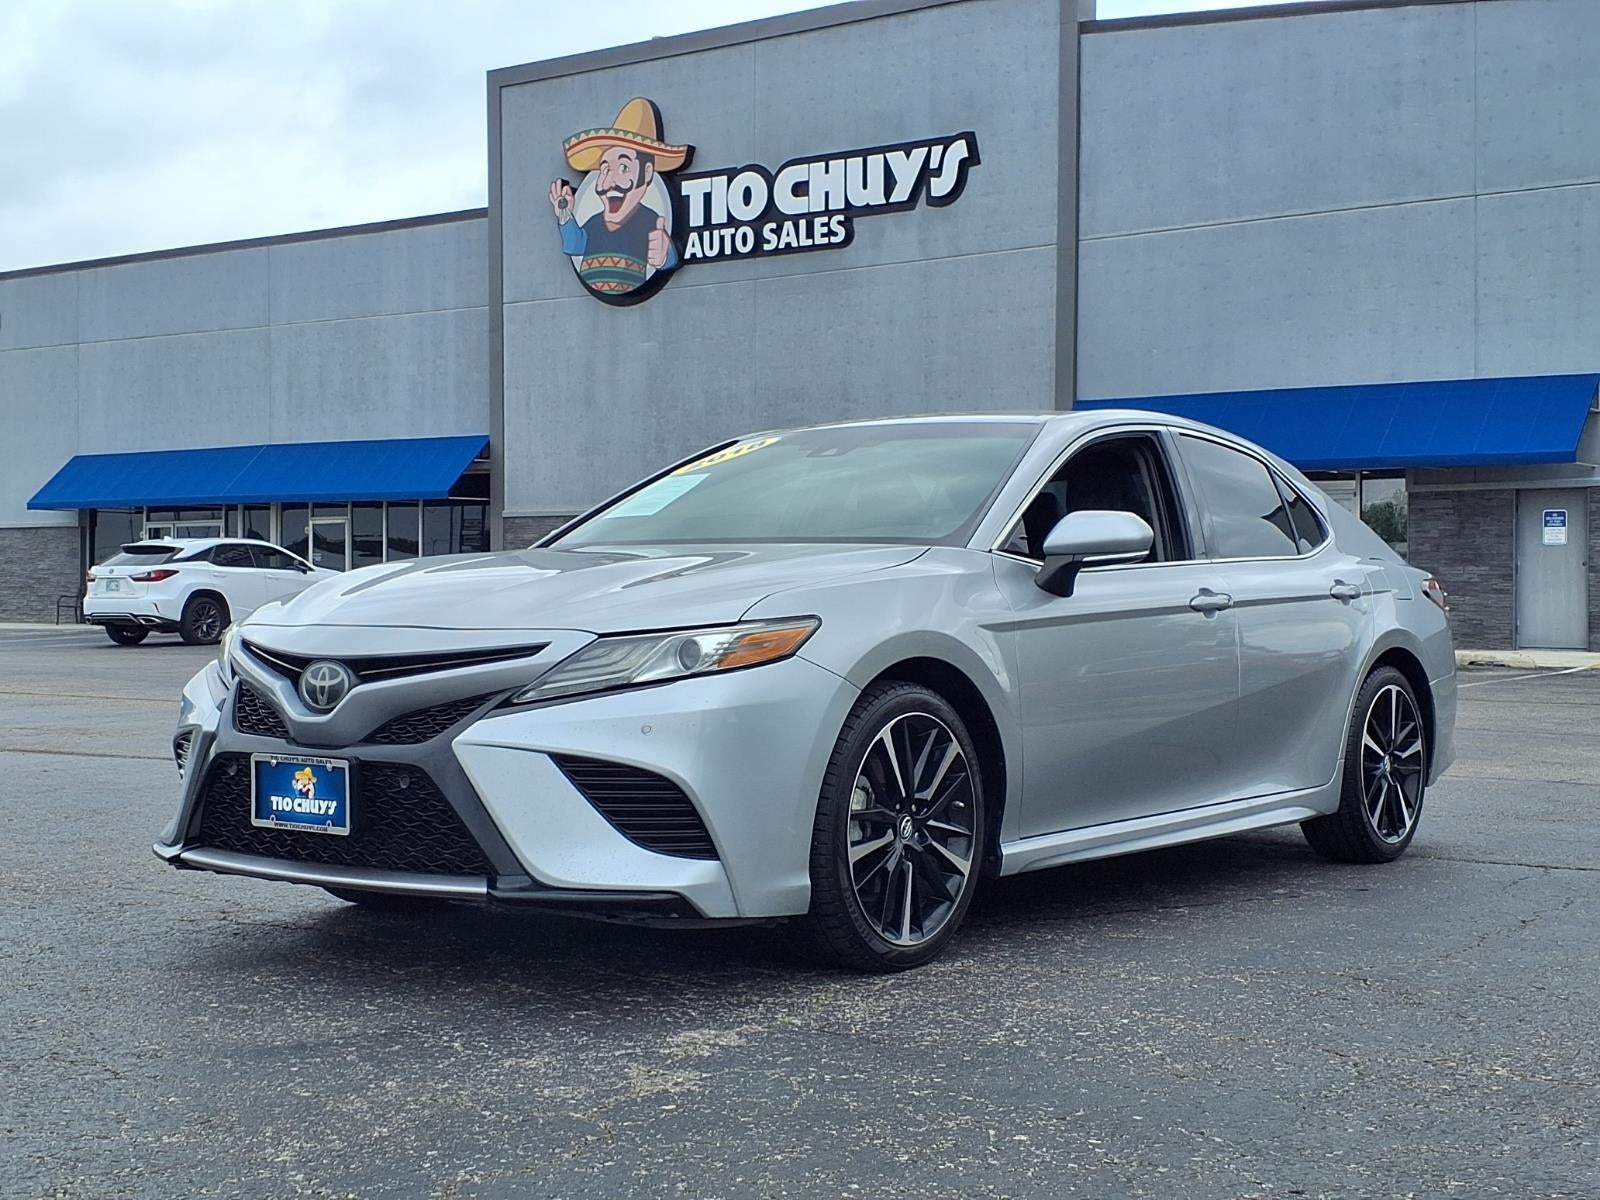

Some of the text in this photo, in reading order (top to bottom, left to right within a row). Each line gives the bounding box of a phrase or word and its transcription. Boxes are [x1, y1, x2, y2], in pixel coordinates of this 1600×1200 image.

[681, 138, 969, 228] TIO CHUY'S
[684, 215, 846, 260] AUTO SALES
[270, 796, 337, 816] TIO CHUY'S
